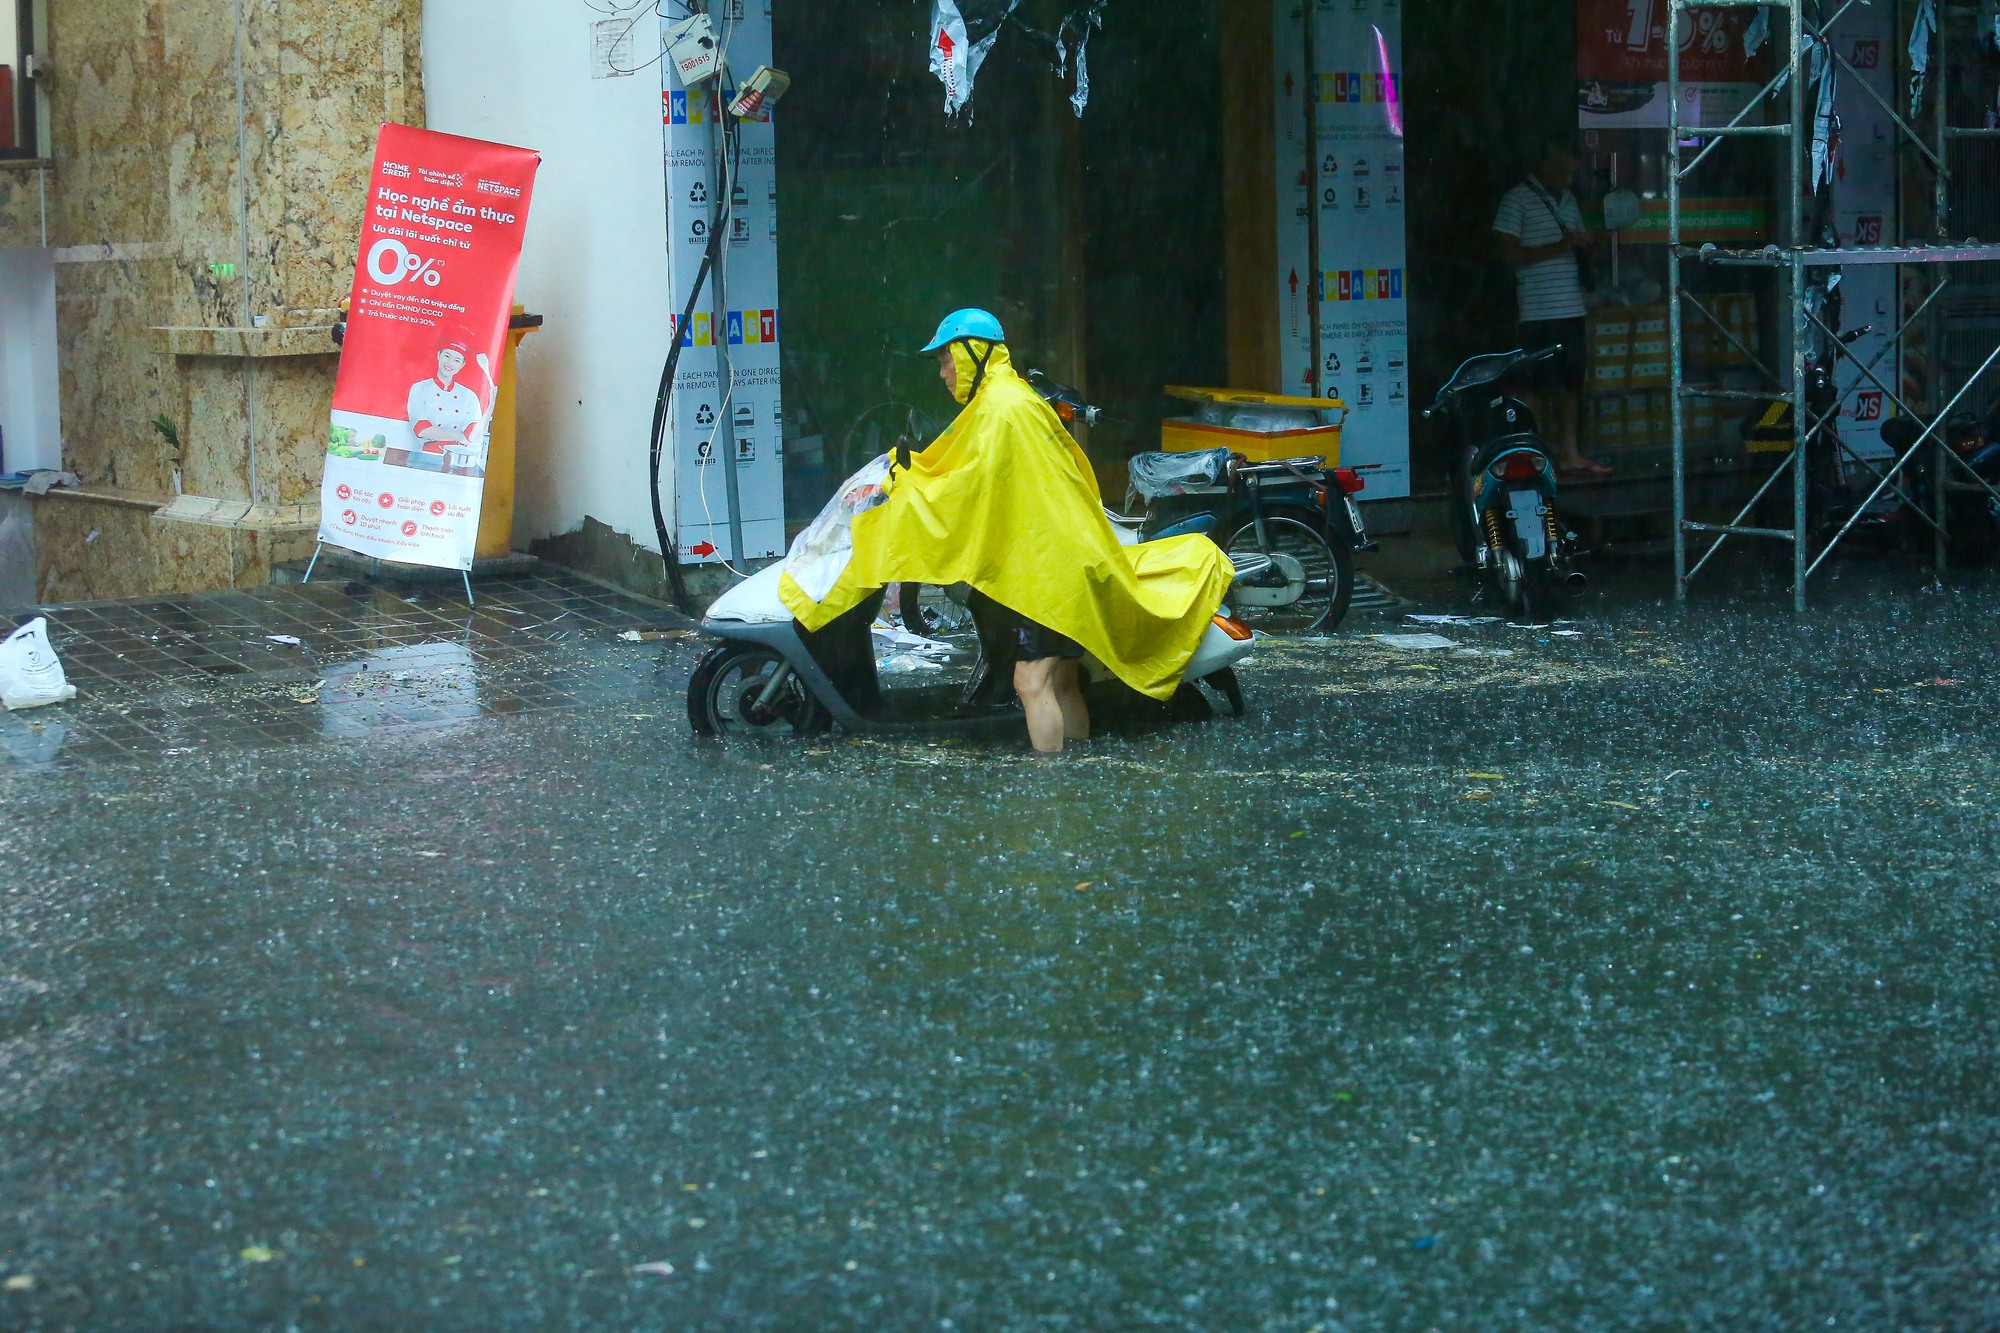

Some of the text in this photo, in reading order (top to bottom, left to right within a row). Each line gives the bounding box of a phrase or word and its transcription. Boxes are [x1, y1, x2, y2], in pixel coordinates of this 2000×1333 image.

[681, 53, 711, 72] 19001515
[677, 149, 696, 157] EACH
[382, 168, 411, 179] CREDIT
[383, 161, 409, 171] HOME
[477, 182, 520, 197] NETSPACE
[378, 187, 516, 225] Học nghề ẩm thực
[376, 204, 474, 233] tại Netspace
[372, 223, 471, 250] Ưu đãi lãi suất chỉ từ
[1856, 221, 1879, 244] SK
[369, 299, 382, 307] Chỉ
[396, 303, 421, 314] CMND/
[421, 308, 444, 318] CCCD
[371, 289, 392, 299] Duyệt
[393, 294, 406, 302] vay
[406, 295, 420, 303] đến
[431, 300, 448, 309] triệu
[448, 303, 466, 314] đồng
[399, 314, 410, 322] chỉ
[419, 318, 436, 327] 30%
[1333, 321, 1350, 329] PANEL
[1320, 331, 1342, 339] REMOVE
[1366, 329, 1384, 337] AFTER
[683, 371, 701, 380] EACH
[704, 369, 718, 378] PAN
[742, 367, 757, 377] ONE
[687, 380, 716, 389] REMOVE
[733, 377, 746, 386] AYS
[748, 374, 768, 385] AFTER
[1857, 397, 1880, 418] SK
[379, 518, 397, 526] nhanh
